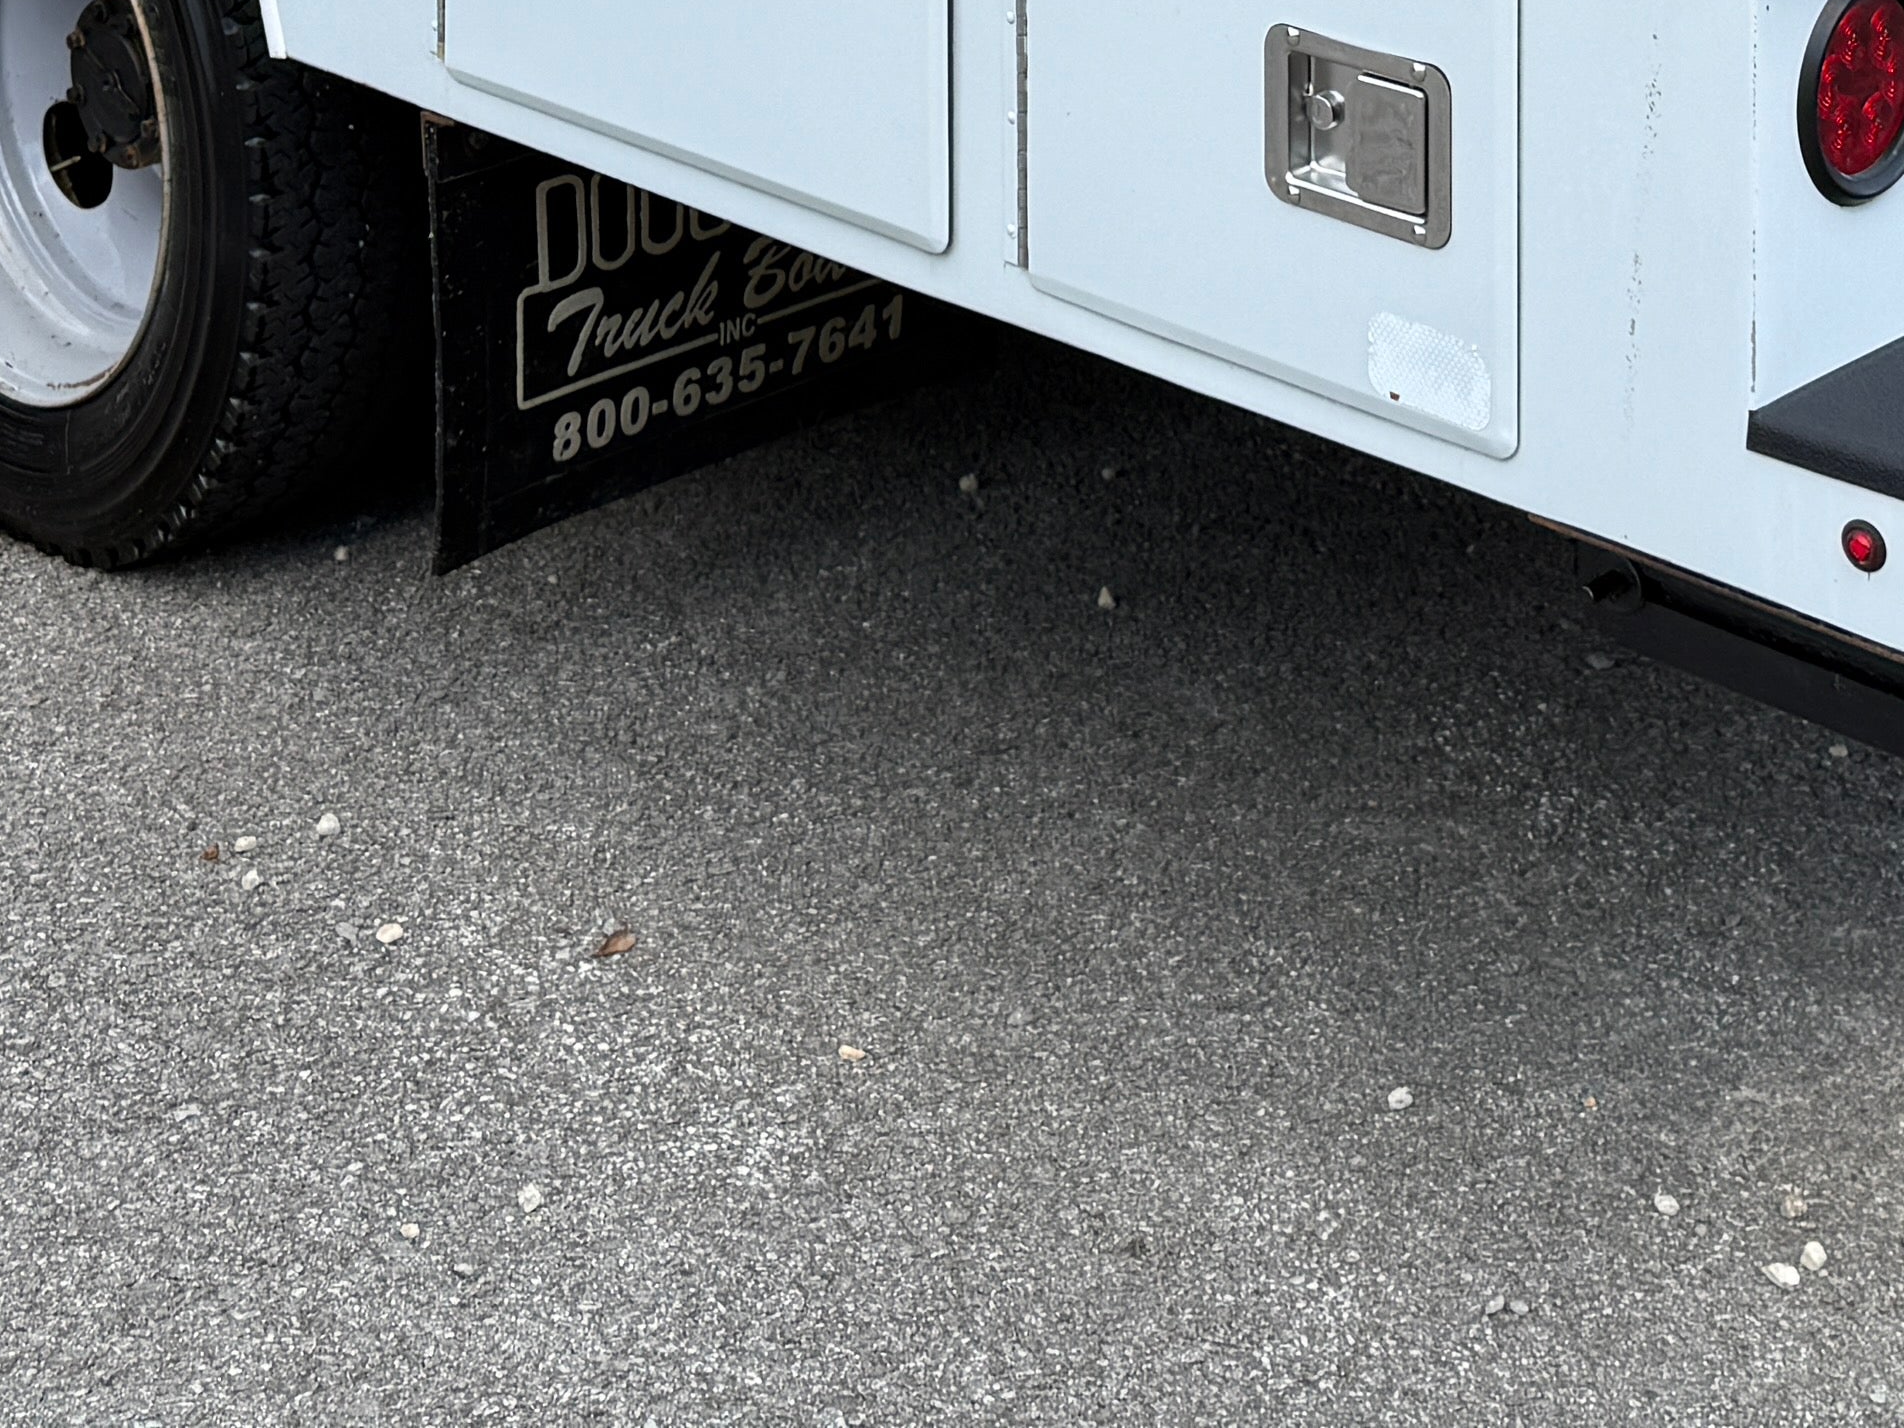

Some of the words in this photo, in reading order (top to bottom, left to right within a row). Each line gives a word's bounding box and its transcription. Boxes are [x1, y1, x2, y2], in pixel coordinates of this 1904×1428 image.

[547, 250, 723, 377] Truck
[719, 312, 758, 346] INC
[552, 294, 904, 463] 800-635-7641
